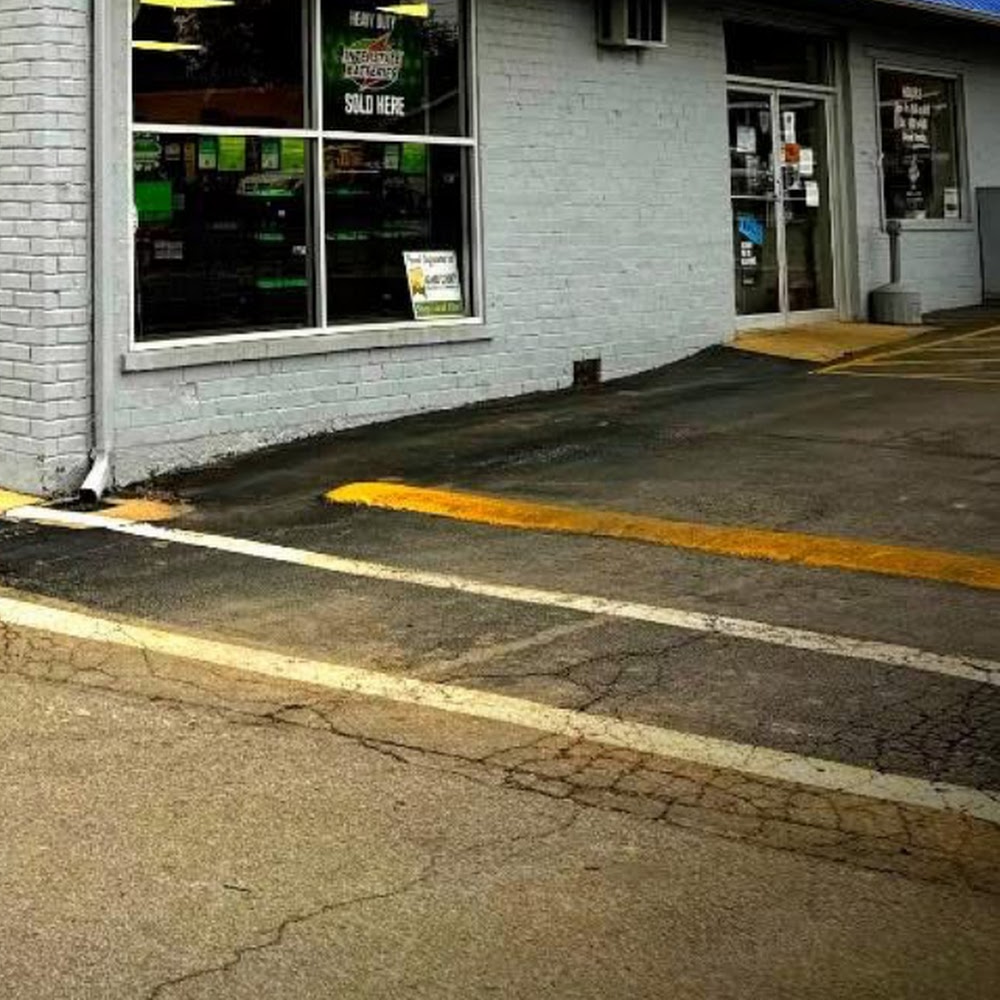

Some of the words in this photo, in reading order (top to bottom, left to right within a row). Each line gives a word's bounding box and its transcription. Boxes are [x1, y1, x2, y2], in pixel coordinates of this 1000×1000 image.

[349, 9, 375, 30] HEAVY
[344, 92, 375, 116] SOLD
[375, 94, 406, 118] HERE
